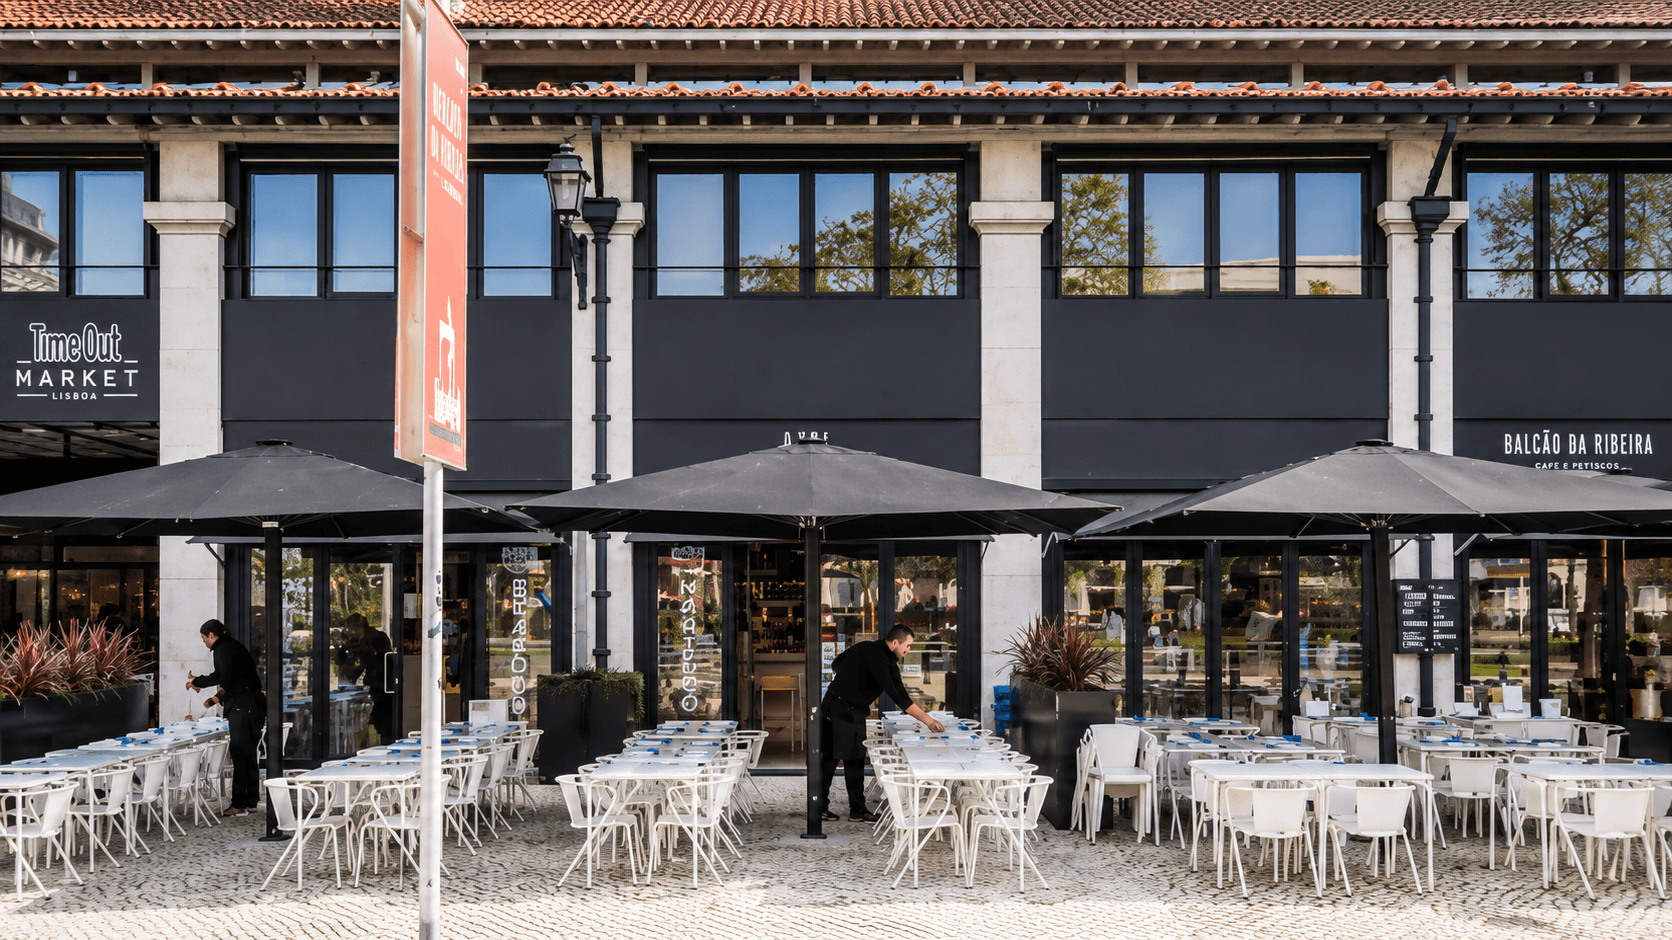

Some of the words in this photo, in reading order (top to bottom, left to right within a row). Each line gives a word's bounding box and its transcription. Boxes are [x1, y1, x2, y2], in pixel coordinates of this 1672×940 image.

[29, 322, 81, 362] Time
[82, 322, 122, 362] Out
[16, 369, 139, 387] MARKET
[52, 392, 97, 400] LISBOA
[1504, 429, 1561, 455] BALCÃO
[1568, 433, 1587, 455] DA
[1594, 433, 1653, 455] RIBEIRA
[1572, 462, 1620, 470] PETISCOS
